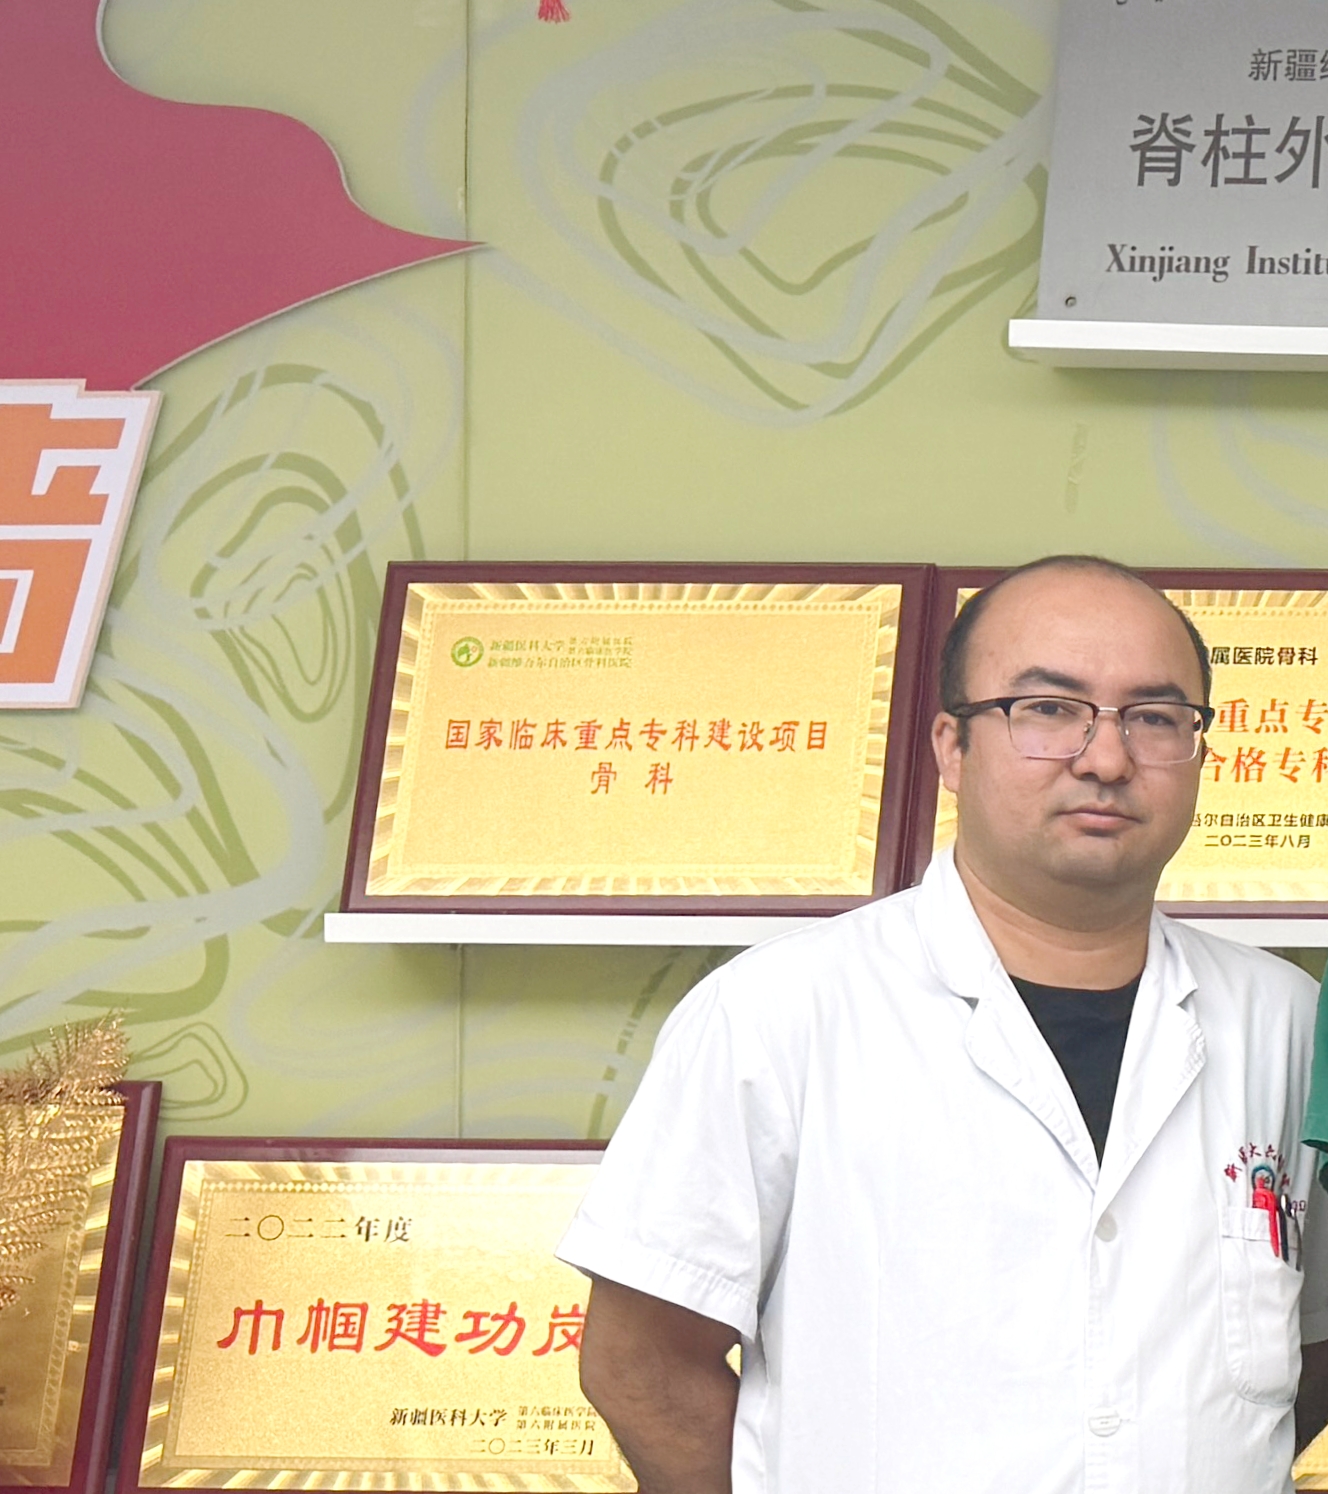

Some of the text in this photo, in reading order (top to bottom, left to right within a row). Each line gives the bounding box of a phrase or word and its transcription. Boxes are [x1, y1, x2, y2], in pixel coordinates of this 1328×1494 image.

[1105, 243, 1229, 283] Xinjiang
[1210, 646, 1319, 665] 属医院骨科
[444, 717, 829, 753] 国家临床重点专科建设项目
[389, 1407, 508, 1428] 新疆医科大学
